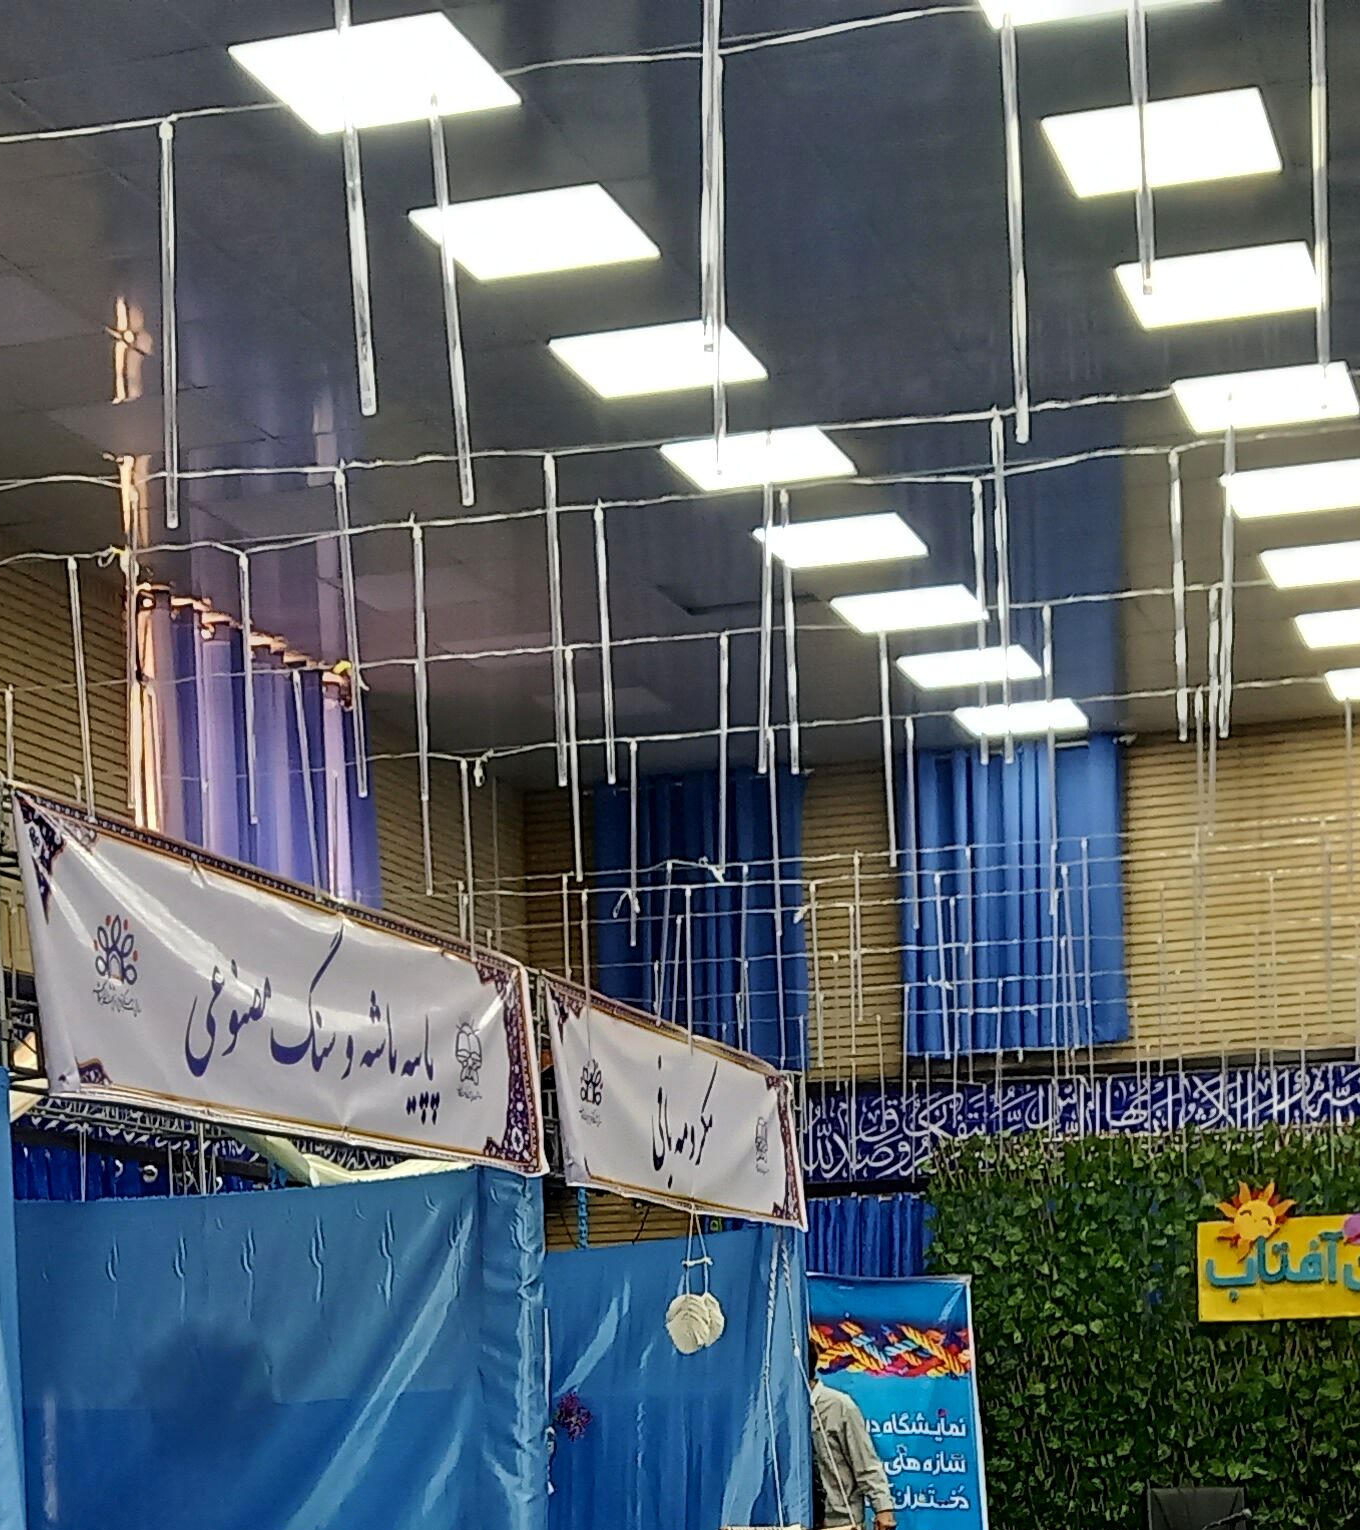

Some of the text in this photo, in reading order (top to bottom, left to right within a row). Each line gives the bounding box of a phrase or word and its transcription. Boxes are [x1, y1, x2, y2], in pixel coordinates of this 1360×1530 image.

[185, 958, 272, 1078] مصنوعی
[270, 922, 344, 1073] سنگ
[1205, 1231, 1343, 1303] آفتاب
[883, 1411, 967, 1442] نمایشگاه
